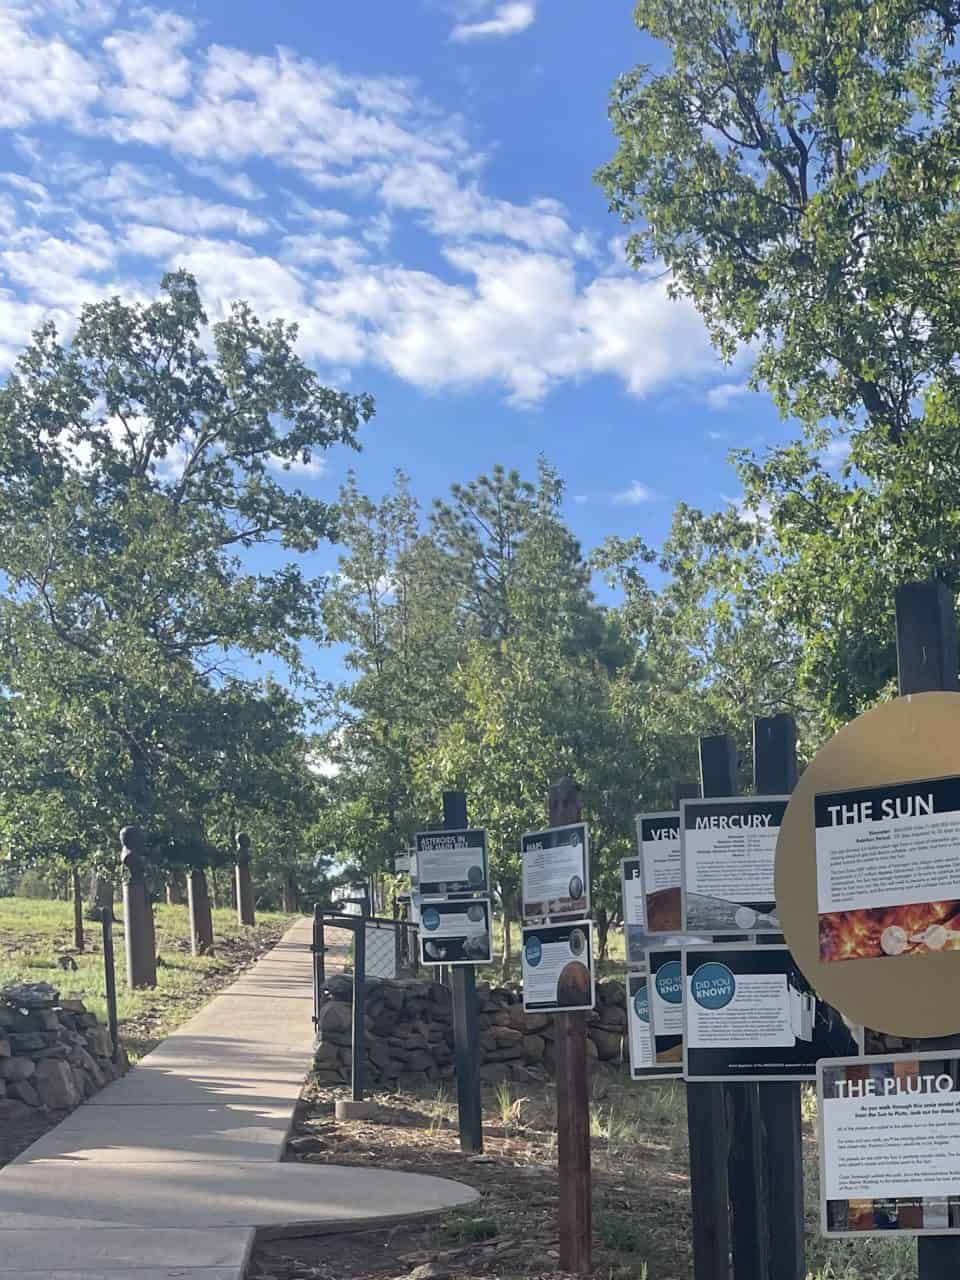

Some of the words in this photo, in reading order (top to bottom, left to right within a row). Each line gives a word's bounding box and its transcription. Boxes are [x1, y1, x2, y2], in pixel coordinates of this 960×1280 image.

[828, 803, 873, 827] THE
[881, 794, 934, 820] SUN
[695, 814, 773, 831] MERCURY
[650, 826, 680, 841] VEN
[660, 983, 682, 994] KNO
[695, 980, 710, 990] DID
[712, 977, 731, 987] YOU
[696, 985, 731, 999] KNOW?
[835, 1080, 876, 1099] THE
[884, 1074, 954, 1096] PLUTO
